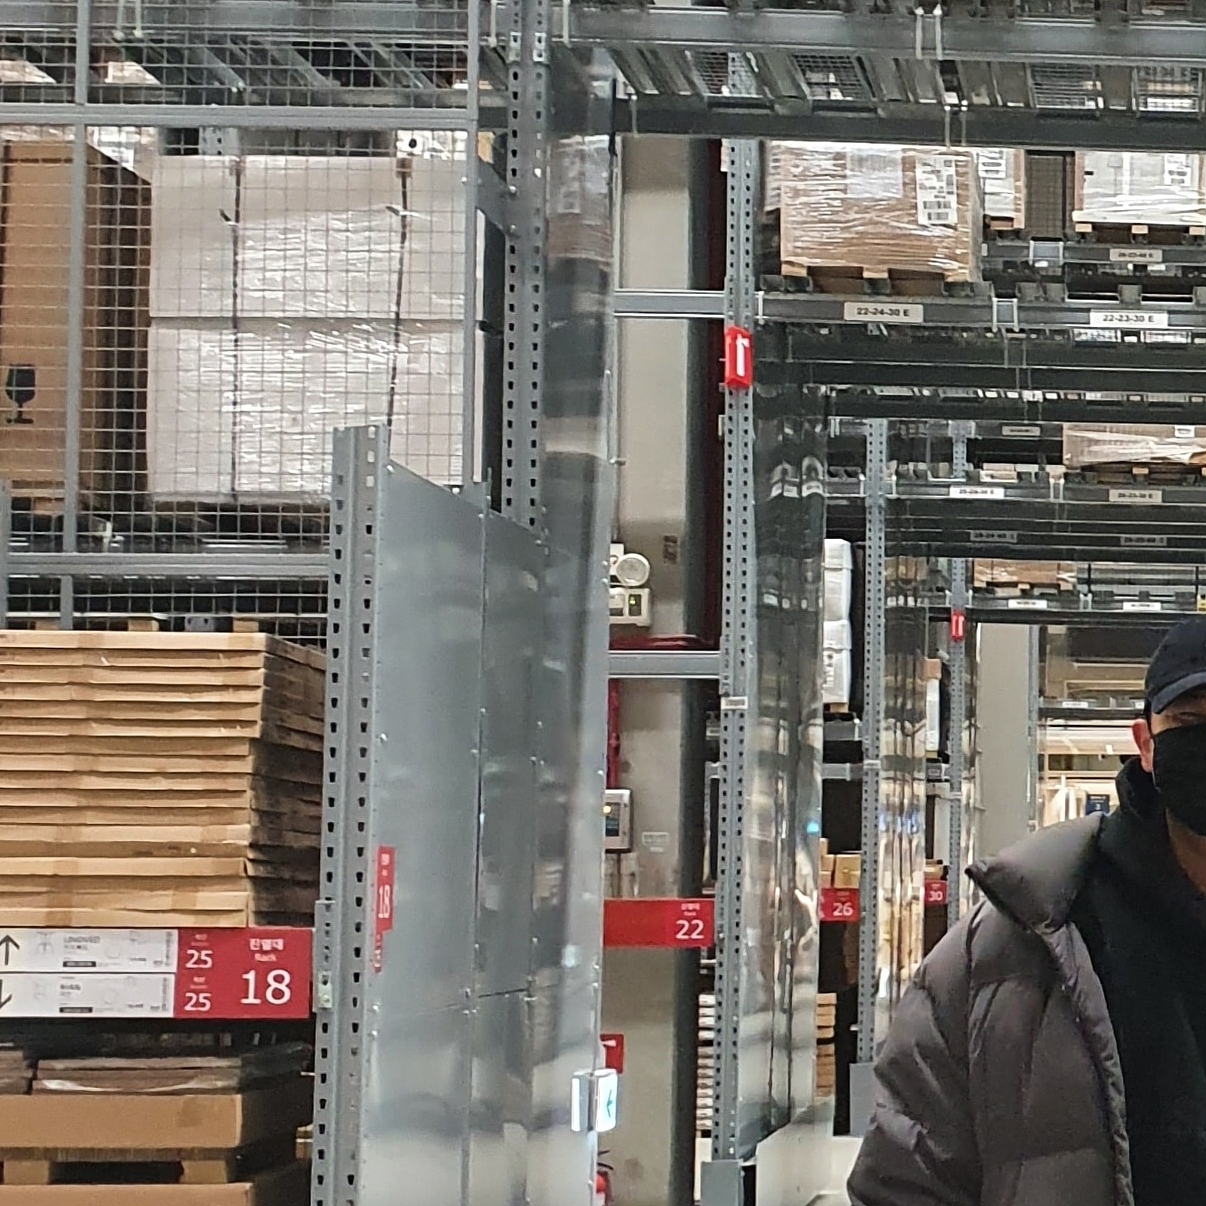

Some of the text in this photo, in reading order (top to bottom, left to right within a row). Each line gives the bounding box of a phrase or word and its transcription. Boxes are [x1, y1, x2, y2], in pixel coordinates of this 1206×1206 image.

[1148, 314, 1155, 323] E
[378, 884, 391, 918] 18
[832, 901, 854, 917] 26
[675, 919, 705, 939] 22
[184, 949, 213, 969] 25
[240, 969, 291, 1005] 18
[183, 992, 212, 1012] 25
